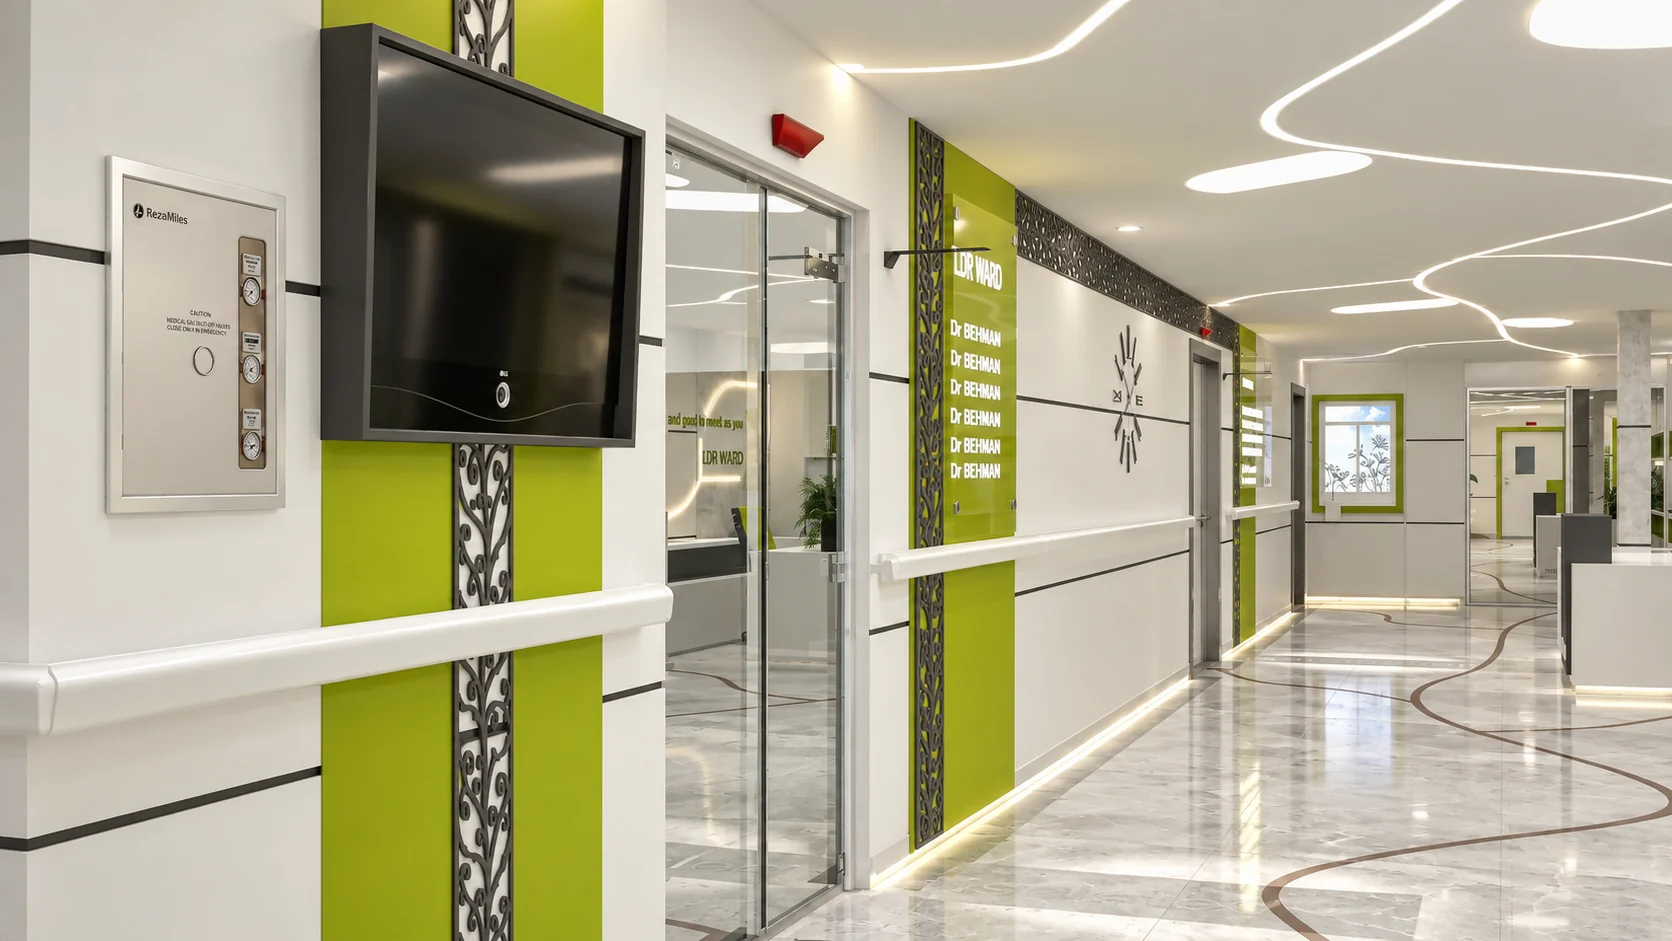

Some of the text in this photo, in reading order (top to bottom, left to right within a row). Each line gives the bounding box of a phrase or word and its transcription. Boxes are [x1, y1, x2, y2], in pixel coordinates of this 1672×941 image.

[146, 207, 188, 225] RezaMiles
[954, 250, 1003, 291] LDR WARD
[950, 319, 1001, 348] Dr BEHMAN
[950, 349, 1001, 375] Dr BEHMAN
[950, 378, 1001, 401] Dr BEHMAN
[667, 413, 681, 426] and
[705, 416, 723, 428] meet
[723, 419, 732, 429] as
[732, 419, 744, 431] you
[950, 407, 1001, 428] Dr BEHMAN
[950, 436, 1001, 455] Dr BEHMAN
[702, 450, 744, 465] LDR WARD
[950, 462, 1001, 479] Dr BEHMAN
